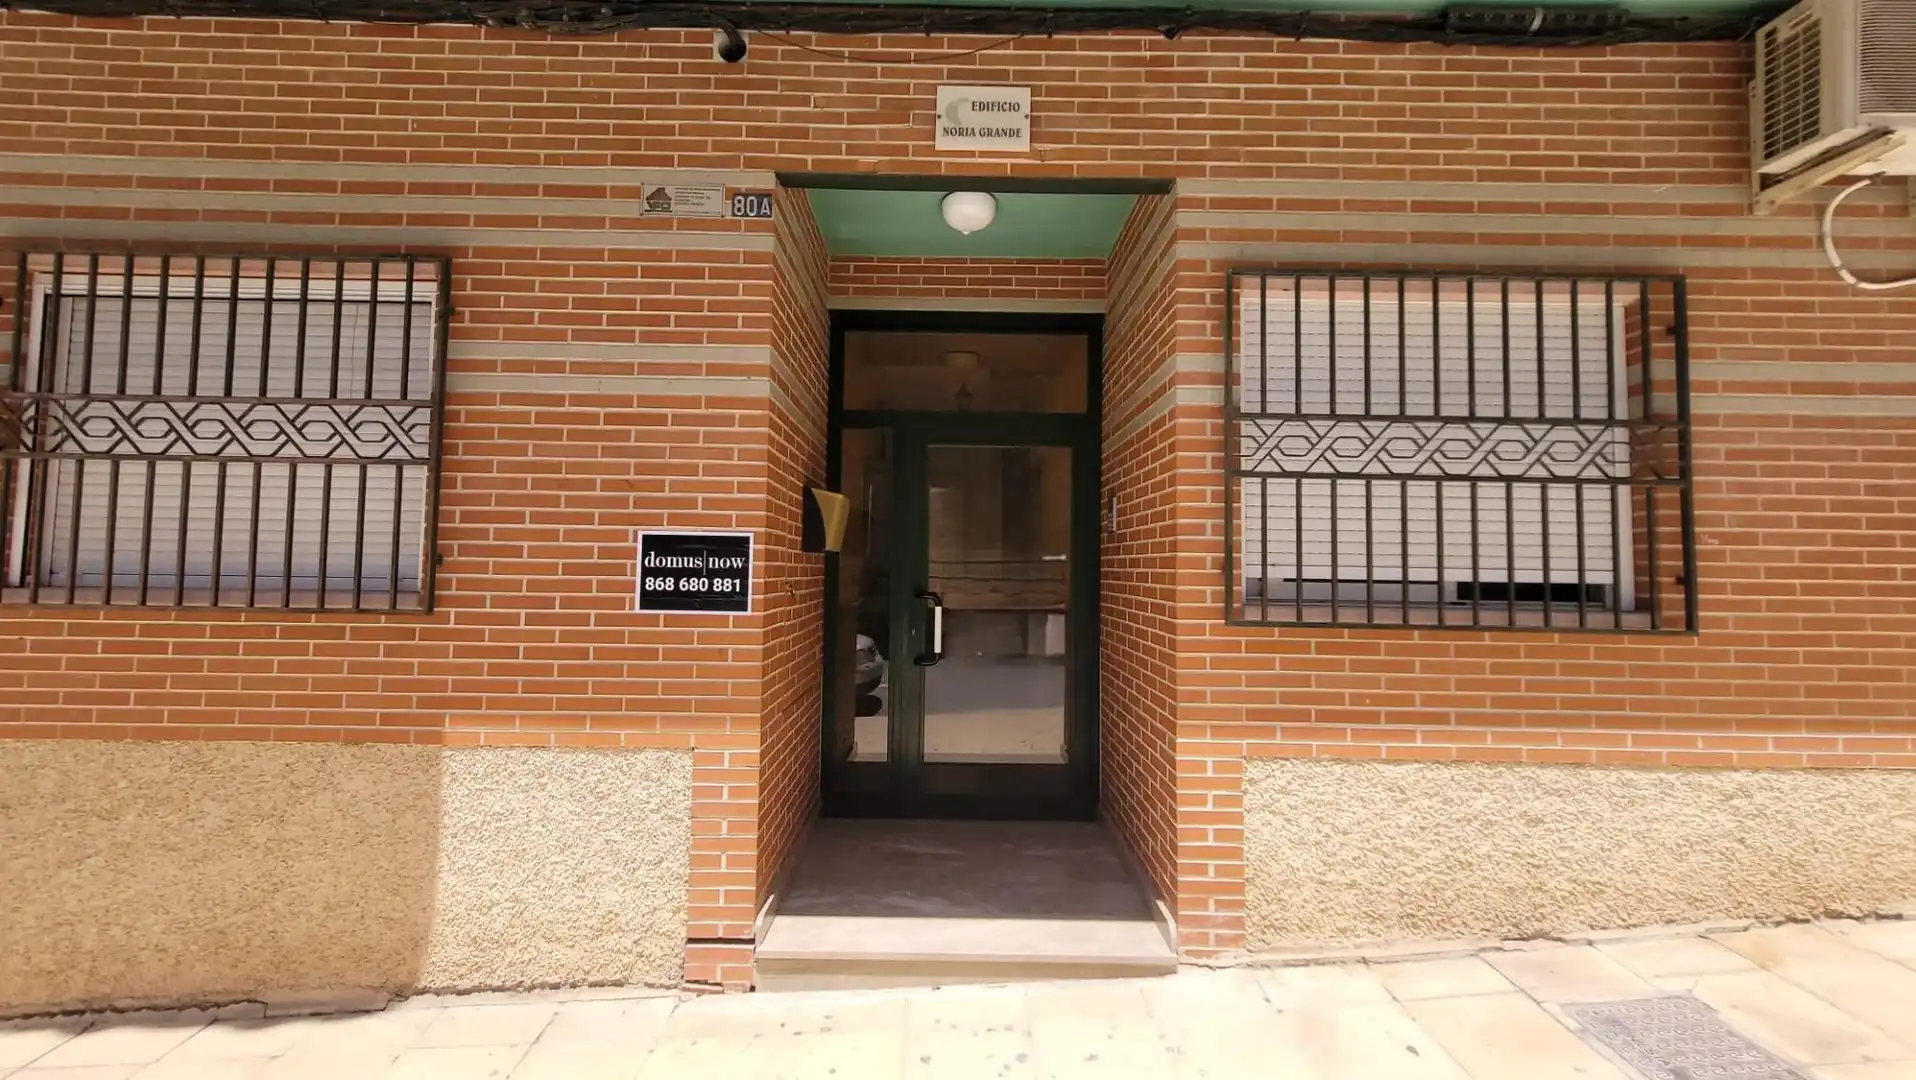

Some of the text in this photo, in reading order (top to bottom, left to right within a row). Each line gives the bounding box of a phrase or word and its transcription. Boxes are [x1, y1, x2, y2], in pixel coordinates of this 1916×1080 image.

[971, 100, 1020, 112] EDIFICIO
[942, 127, 1023, 138] NORIA GRANDE
[644, 551, 746, 569] domus now
[645, 577, 741, 592] 868 680 881
